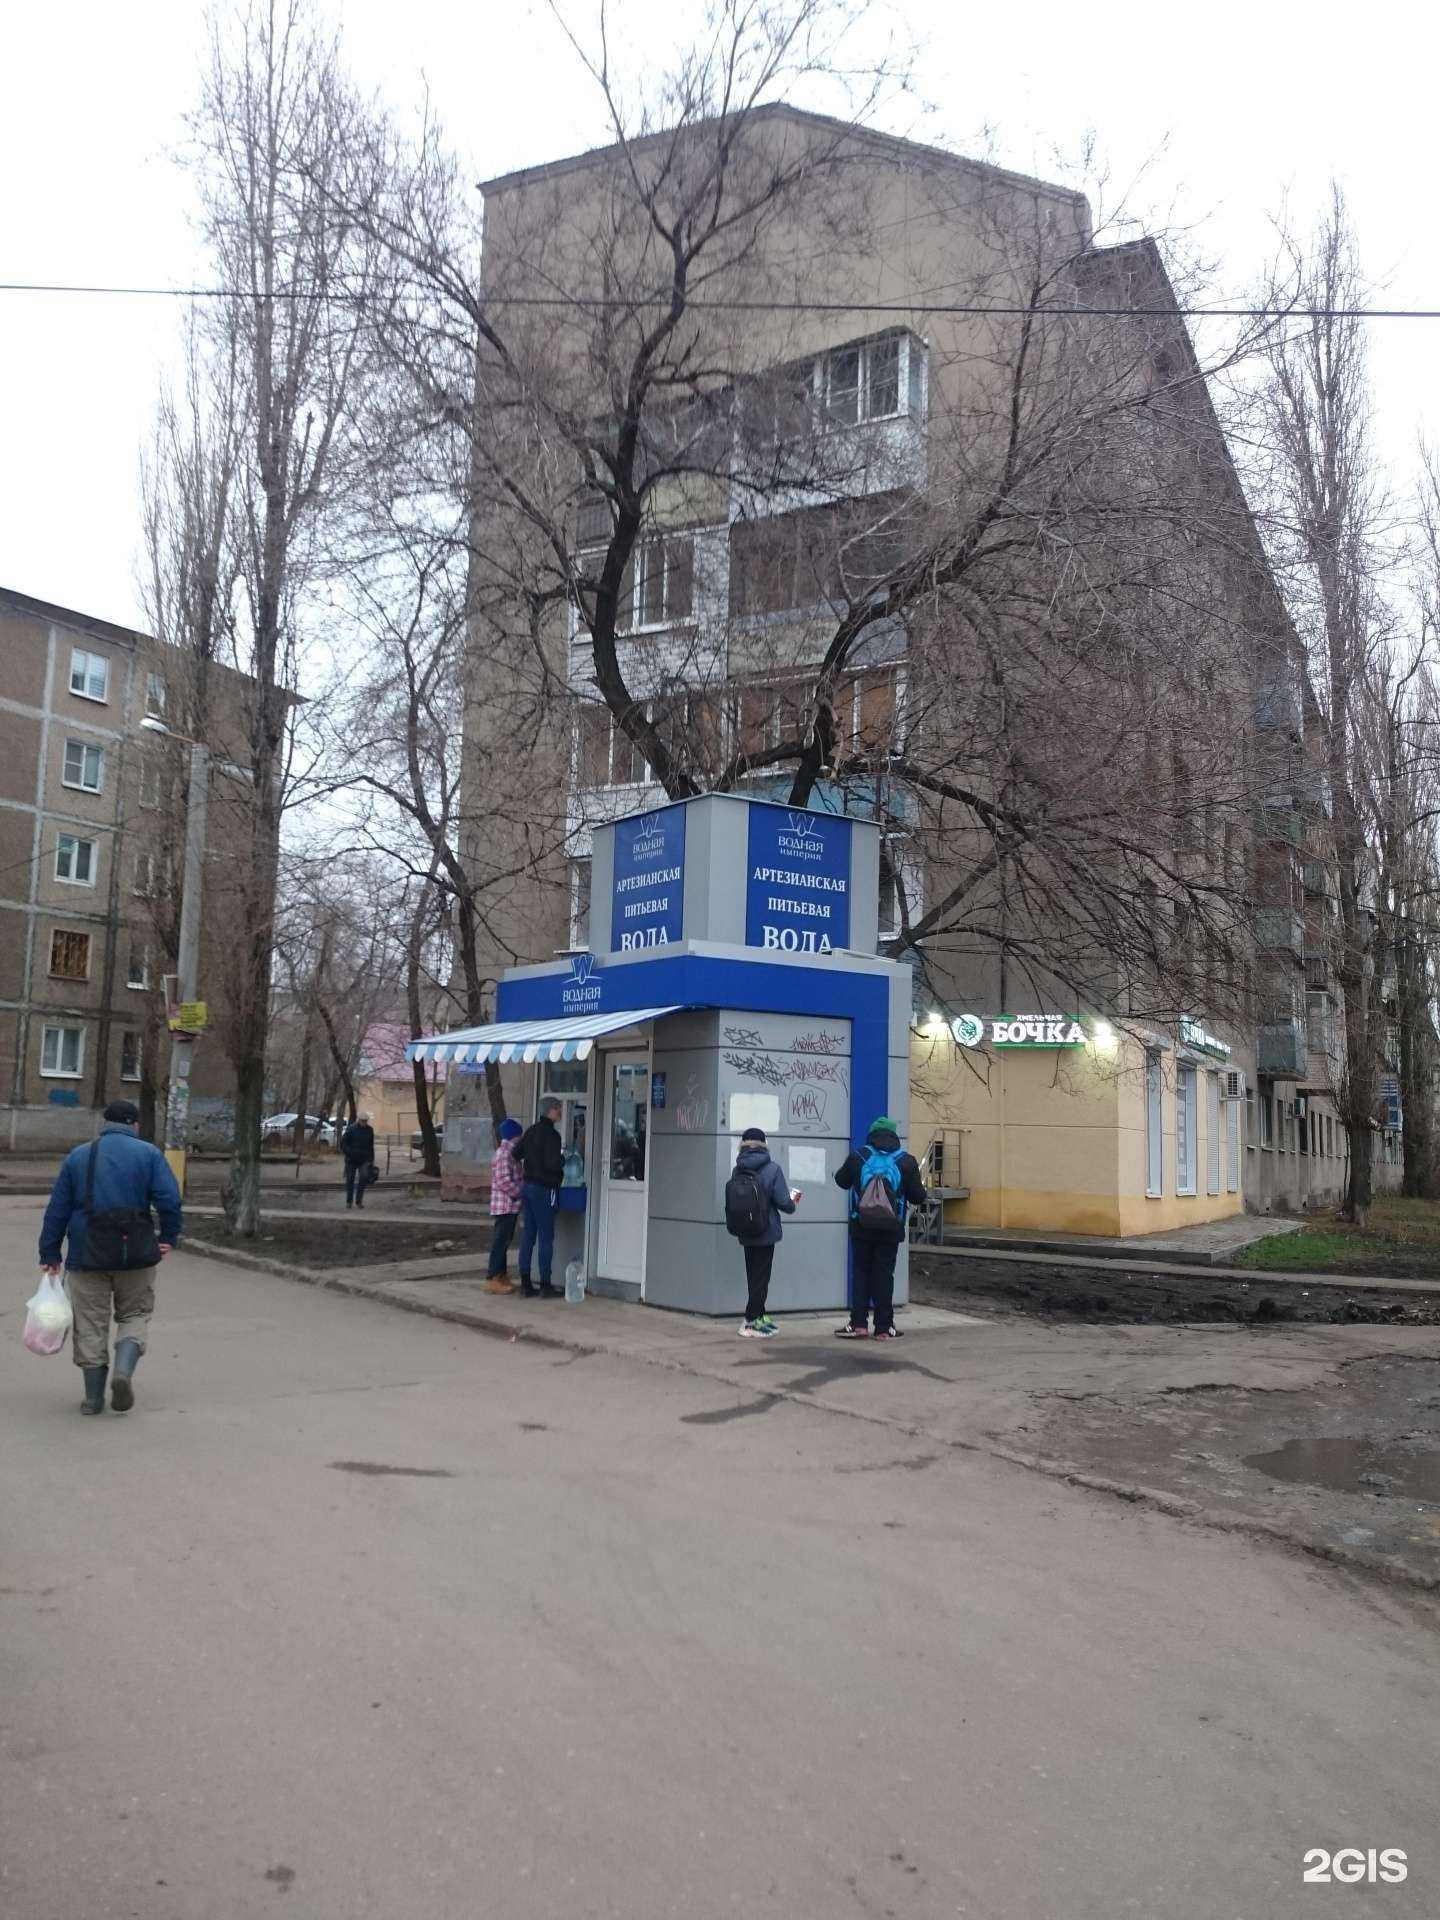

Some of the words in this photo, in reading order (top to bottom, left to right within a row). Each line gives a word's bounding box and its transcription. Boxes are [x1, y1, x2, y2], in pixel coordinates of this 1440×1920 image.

[616, 866, 681, 892] АРТЕЗИАНСКАЯ
[753, 867, 846, 892] АРТЕЗИАНСКАЯ
[624, 898, 669, 918] ПИТЬЕВАЯ
[768, 897, 831, 918] ПИТЬЕВАЯ
[762, 925, 832, 953] ВОДА
[991, 1022, 1088, 1043] БОЧКА
